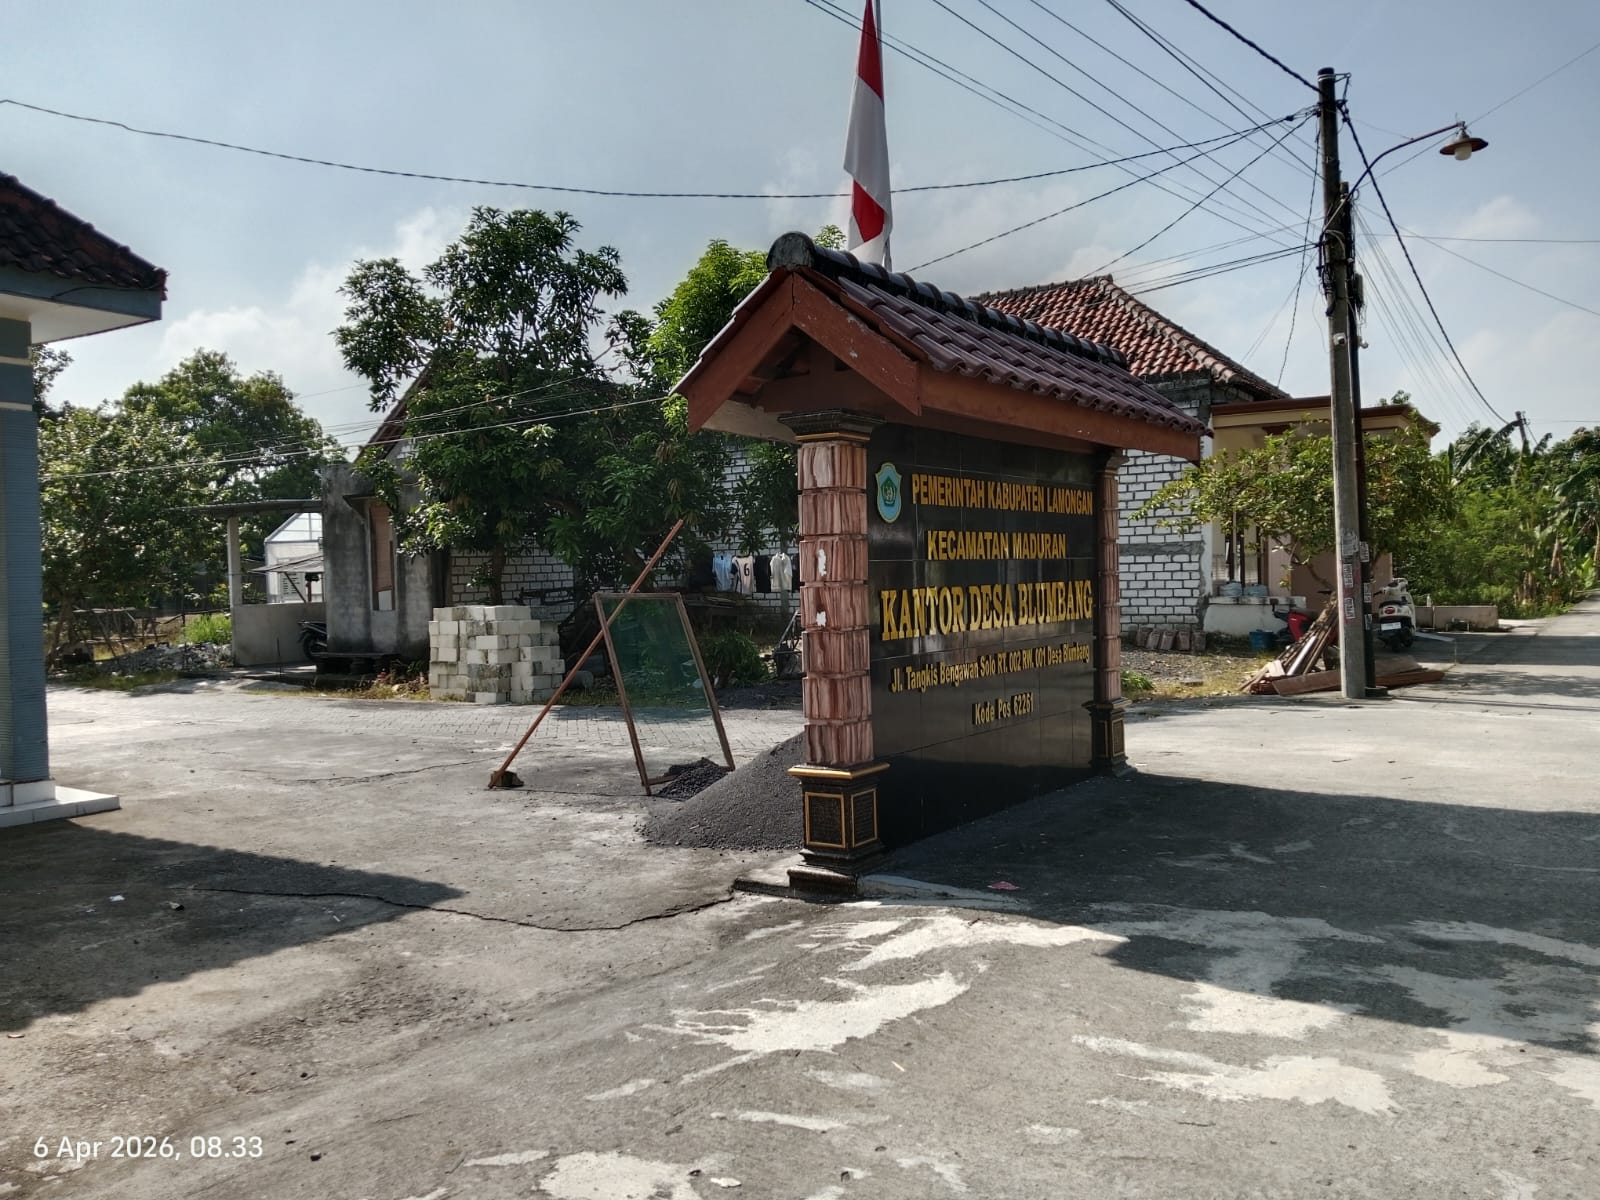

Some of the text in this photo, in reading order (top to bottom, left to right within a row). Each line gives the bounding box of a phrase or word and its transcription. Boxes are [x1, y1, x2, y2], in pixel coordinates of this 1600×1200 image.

[912, 474, 1093, 515] PEMERINTAH KABUPATEN LAMONGAN
[927, 530, 1066, 561] KECAMATAN MADURAN
[743, 563, 750, 576] 6
[881, 580, 1093, 641] KANTOR DESA BLUMBANG
[906, 663, 938, 693] Tangkis
[940, 661, 979, 687] Bengawan
[980, 655, 996, 677] Solo
[998, 653, 1008, 674] RT.
[1009, 651, 1022, 672] 002
[1035, 646, 1046, 667] 001
[1047, 645, 1062, 665] Desa
[1063, 642, 1090, 664] Blumbang
[975, 691, 1034, 725] Kode Pos 62261
